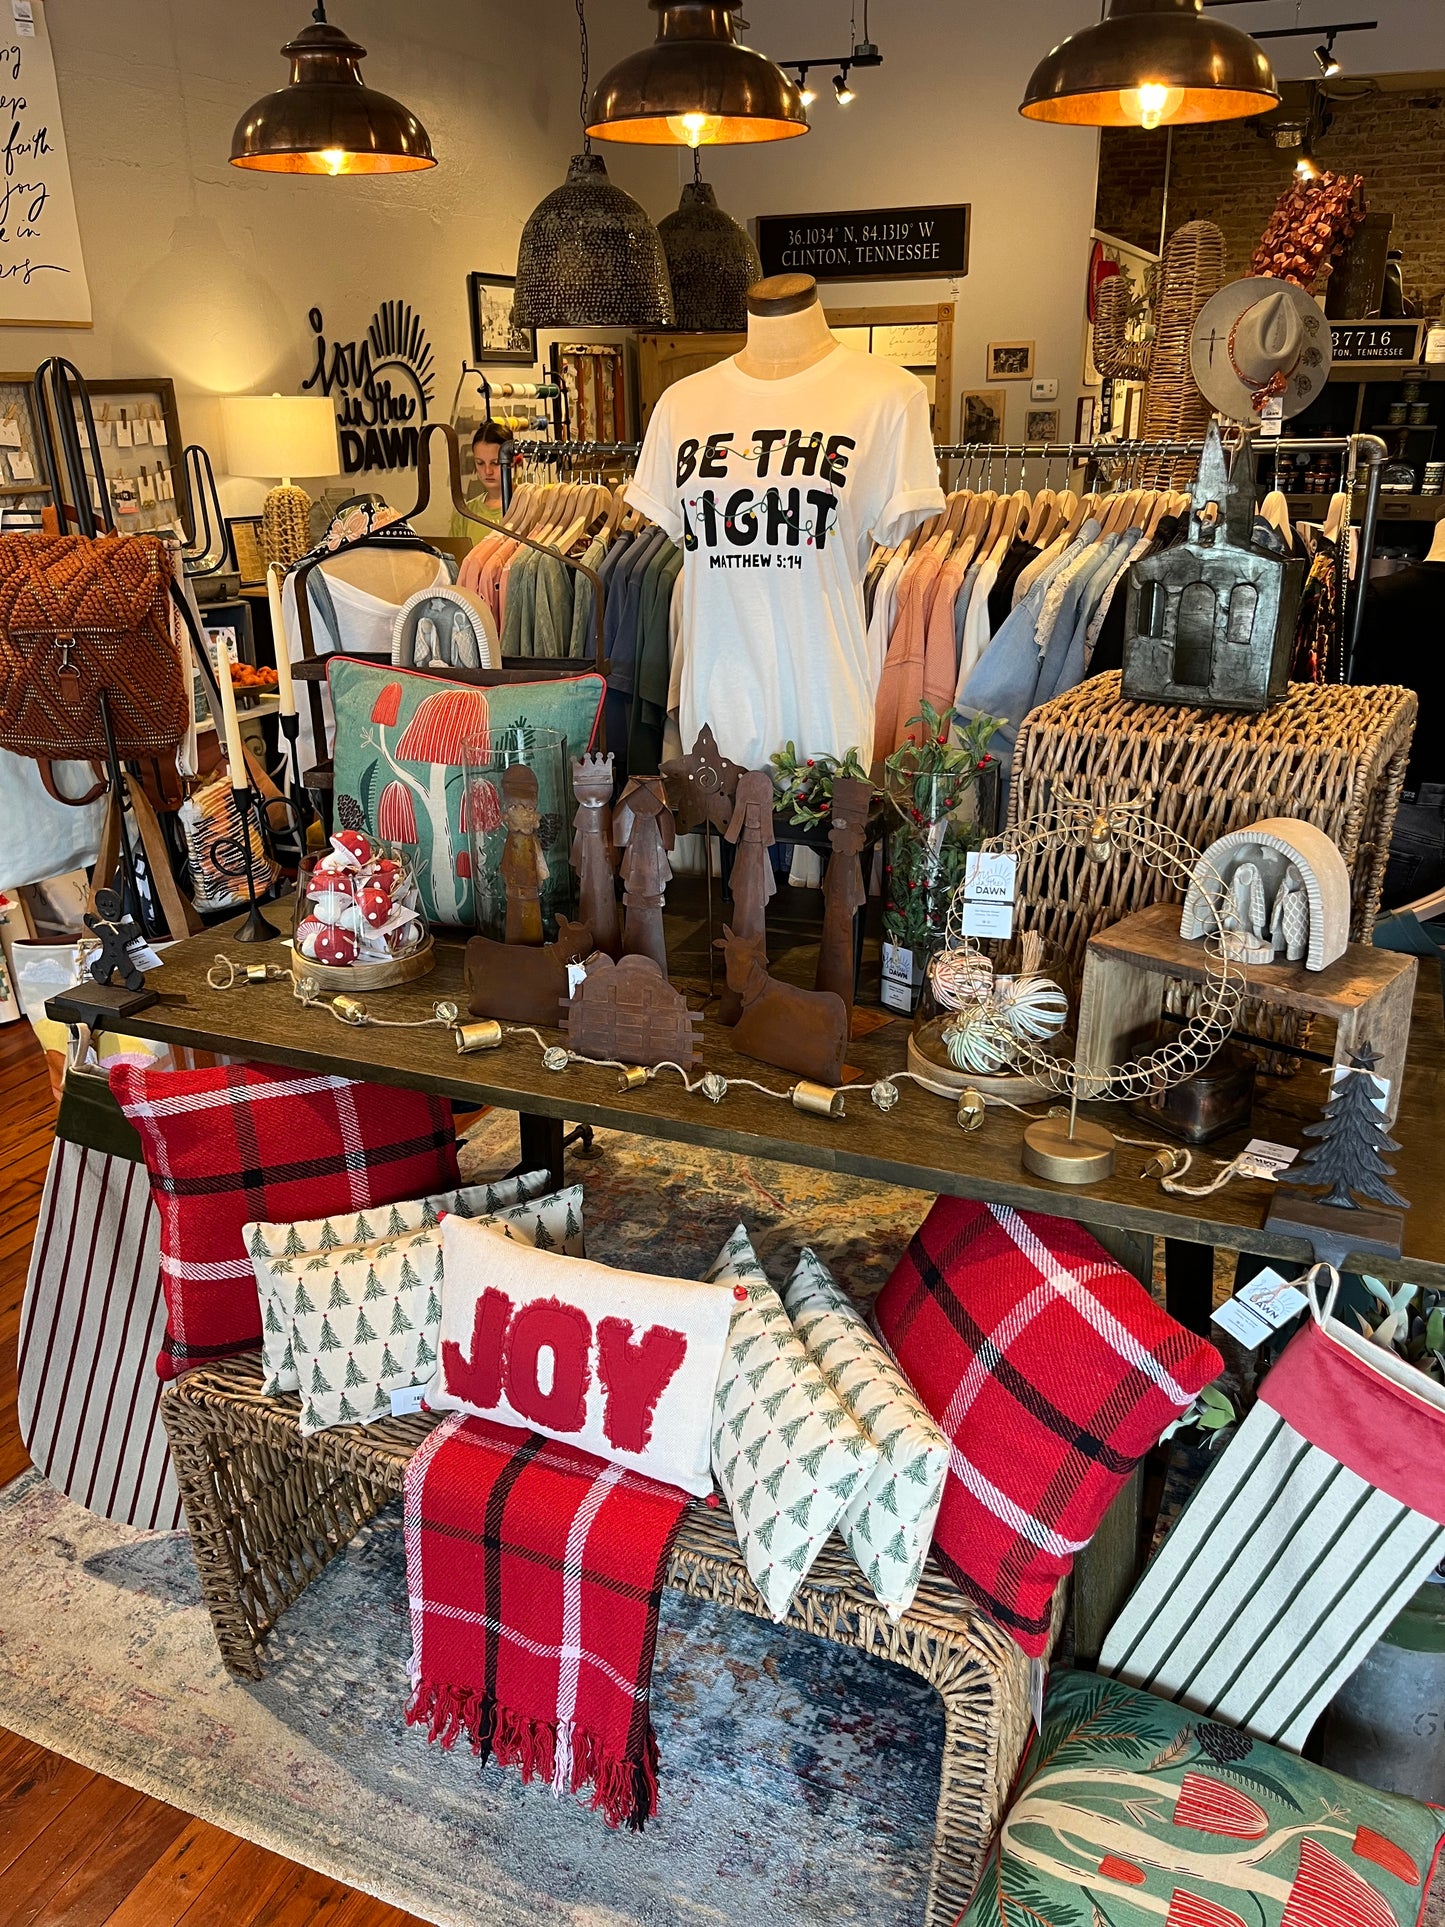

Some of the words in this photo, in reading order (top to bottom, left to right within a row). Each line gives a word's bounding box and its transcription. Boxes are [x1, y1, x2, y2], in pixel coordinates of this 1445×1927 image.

[2, 121, 54, 176] faith
[0, 177, 50, 225] joy
[17, 219, 40, 238] in
[919, 221, 935, 238] W
[781, 248, 851, 266] CLINTON,
[856, 242, 940, 263] TENNESSEE
[1331, 331, 1391, 347] 37716
[302, 307, 377, 402] joy
[1332, 348, 1352, 357] TON,
[1357, 347, 1404, 356] TENNESSEE
[375, 380, 416, 425] the
[676, 432, 735, 489] BE
[751, 429, 856, 488] THE
[680, 487, 839, 552] LIGHT
[709, 554, 772, 570] MATTHEW
[776, 555, 802, 570] 5:14
[975, 886, 1007, 896] DAWN
[888, 968, 908, 980] DAWN
[441, 1285, 688, 1454] JOY
